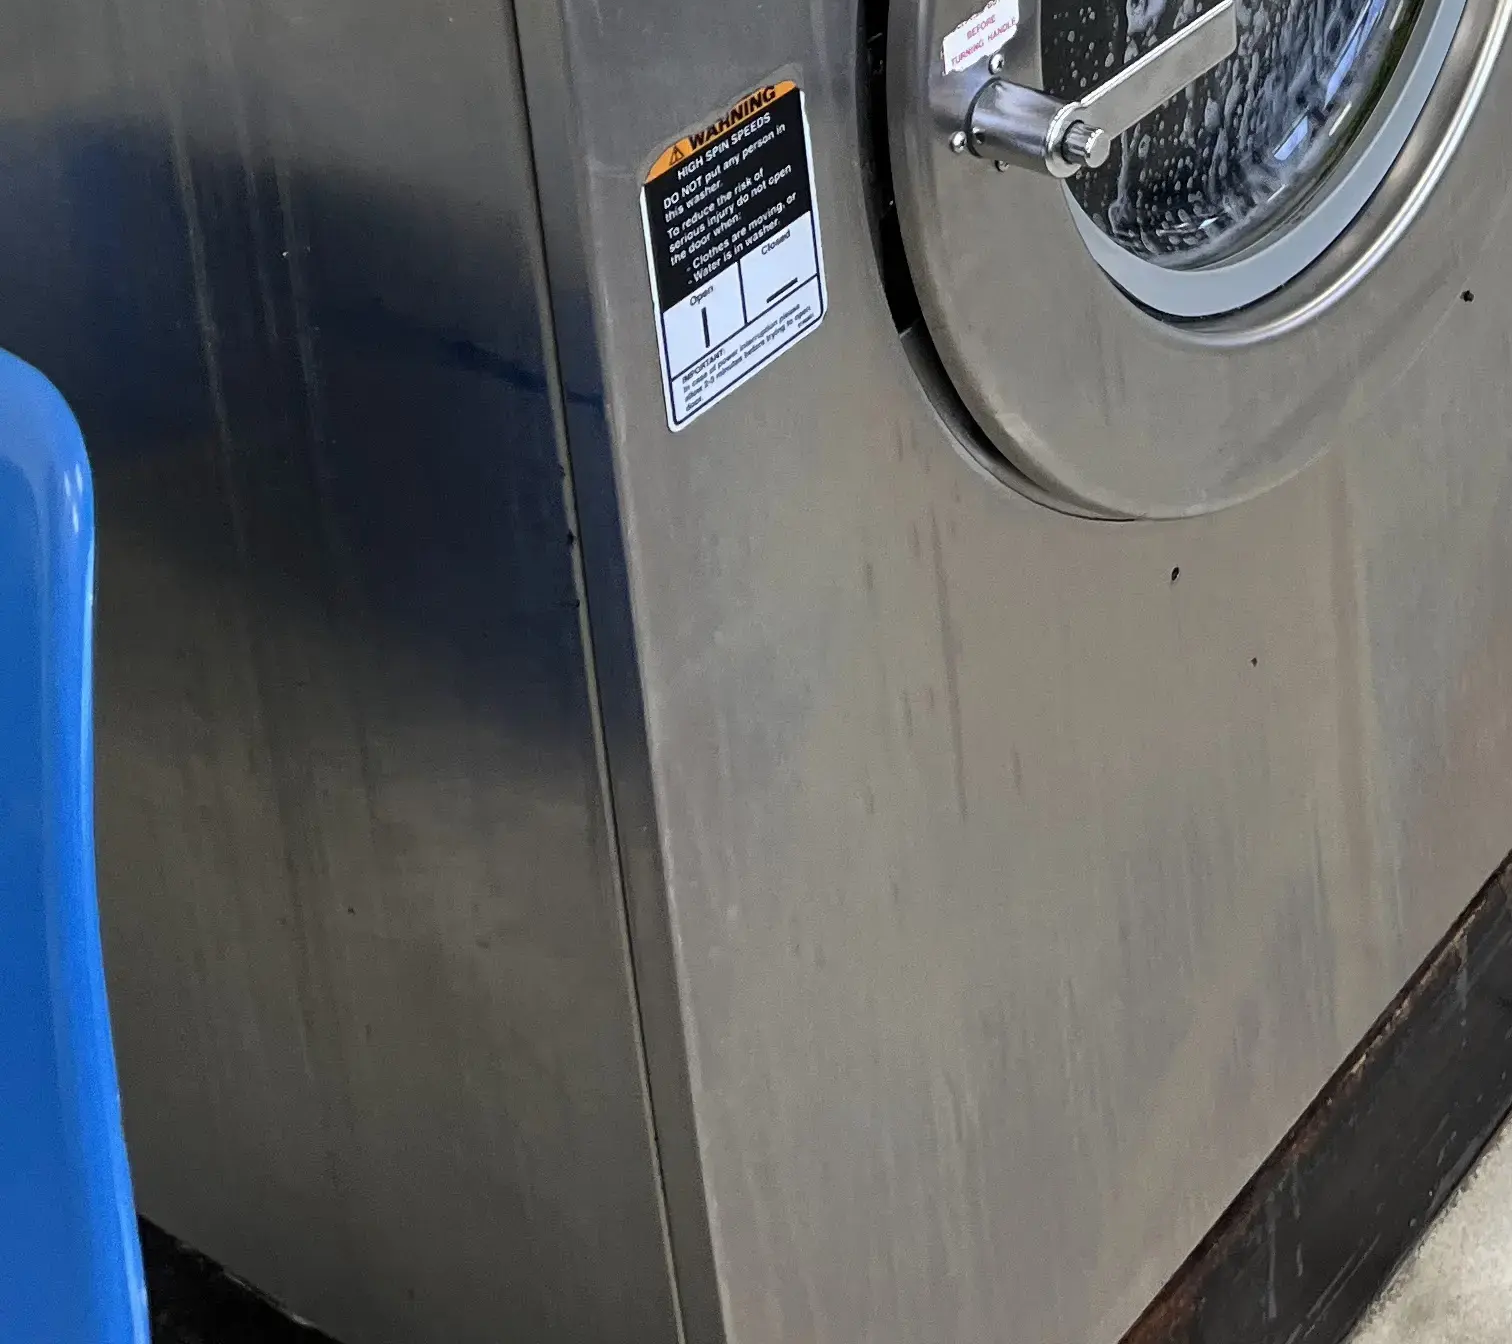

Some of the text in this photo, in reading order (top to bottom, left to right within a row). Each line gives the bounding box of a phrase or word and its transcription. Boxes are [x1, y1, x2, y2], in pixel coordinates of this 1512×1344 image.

[966, 14, 996, 40] BEFORE
[952, 38, 984, 66] TURNING
[677, 112, 772, 180] HIGH SPIN SPEEDS
[664, 123, 786, 210] DO NOT put any person in
[665, 206, 684, 222] this
[667, 168, 764, 240] To reduce the risk of
[669, 164, 792, 252] serious injury do not open
[692, 192, 797, 270] Clothes are moving, or
[761, 230, 791, 256] Closed
[670, 251, 686, 266] the
[689, 234, 712, 254] door
[694, 260, 722, 283] Water
[724, 250, 732, 262] is
[734, 243, 744, 256] in
[690, 285, 714, 306] Open
